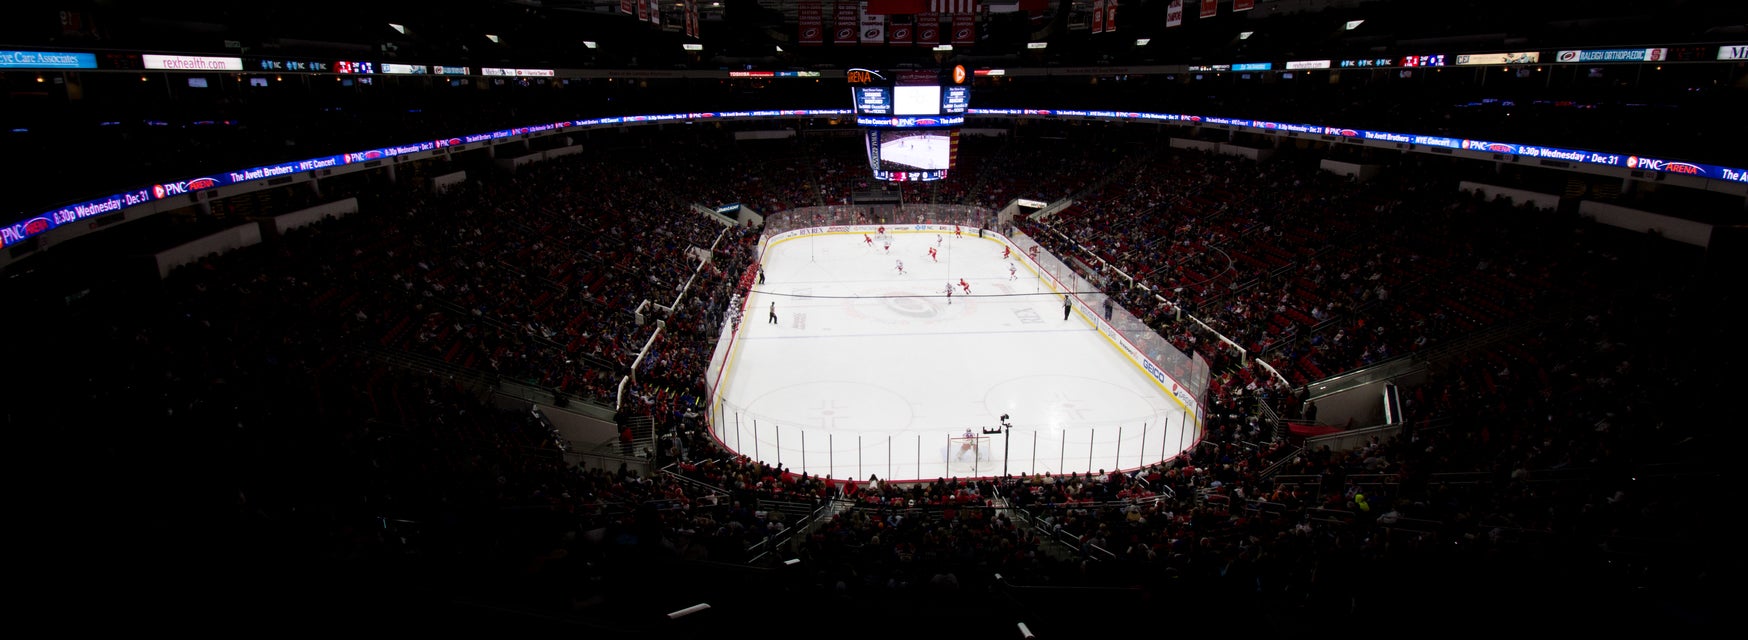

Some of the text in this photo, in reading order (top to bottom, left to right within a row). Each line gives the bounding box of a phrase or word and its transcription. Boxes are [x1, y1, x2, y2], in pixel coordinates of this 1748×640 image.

[14, 52, 36, 63] Care
[37, 53, 79, 64] Associates
[1579, 51, 1603, 60] RALEIGH
[162, 57, 226, 69] rexhealth.com
[899, 118, 915, 126] PNC
[1470, 141, 1487, 150] PNC
[351, 151, 364, 162] PNC
[1518, 146, 1618, 165] 8:30p Wednesday Dec 31
[230, 157, 336, 183] The Avett Brothers NYE Concert
[1638, 157, 1697, 175] PNC ARENA
[1722, 168, 1738, 181] The
[165, 181, 188, 196] PNC
[53, 189, 149, 225] 8:30p Wednesday Dec 31
[1, 223, 24, 244] PNC
[1142, 359, 1165, 383] GEICO
